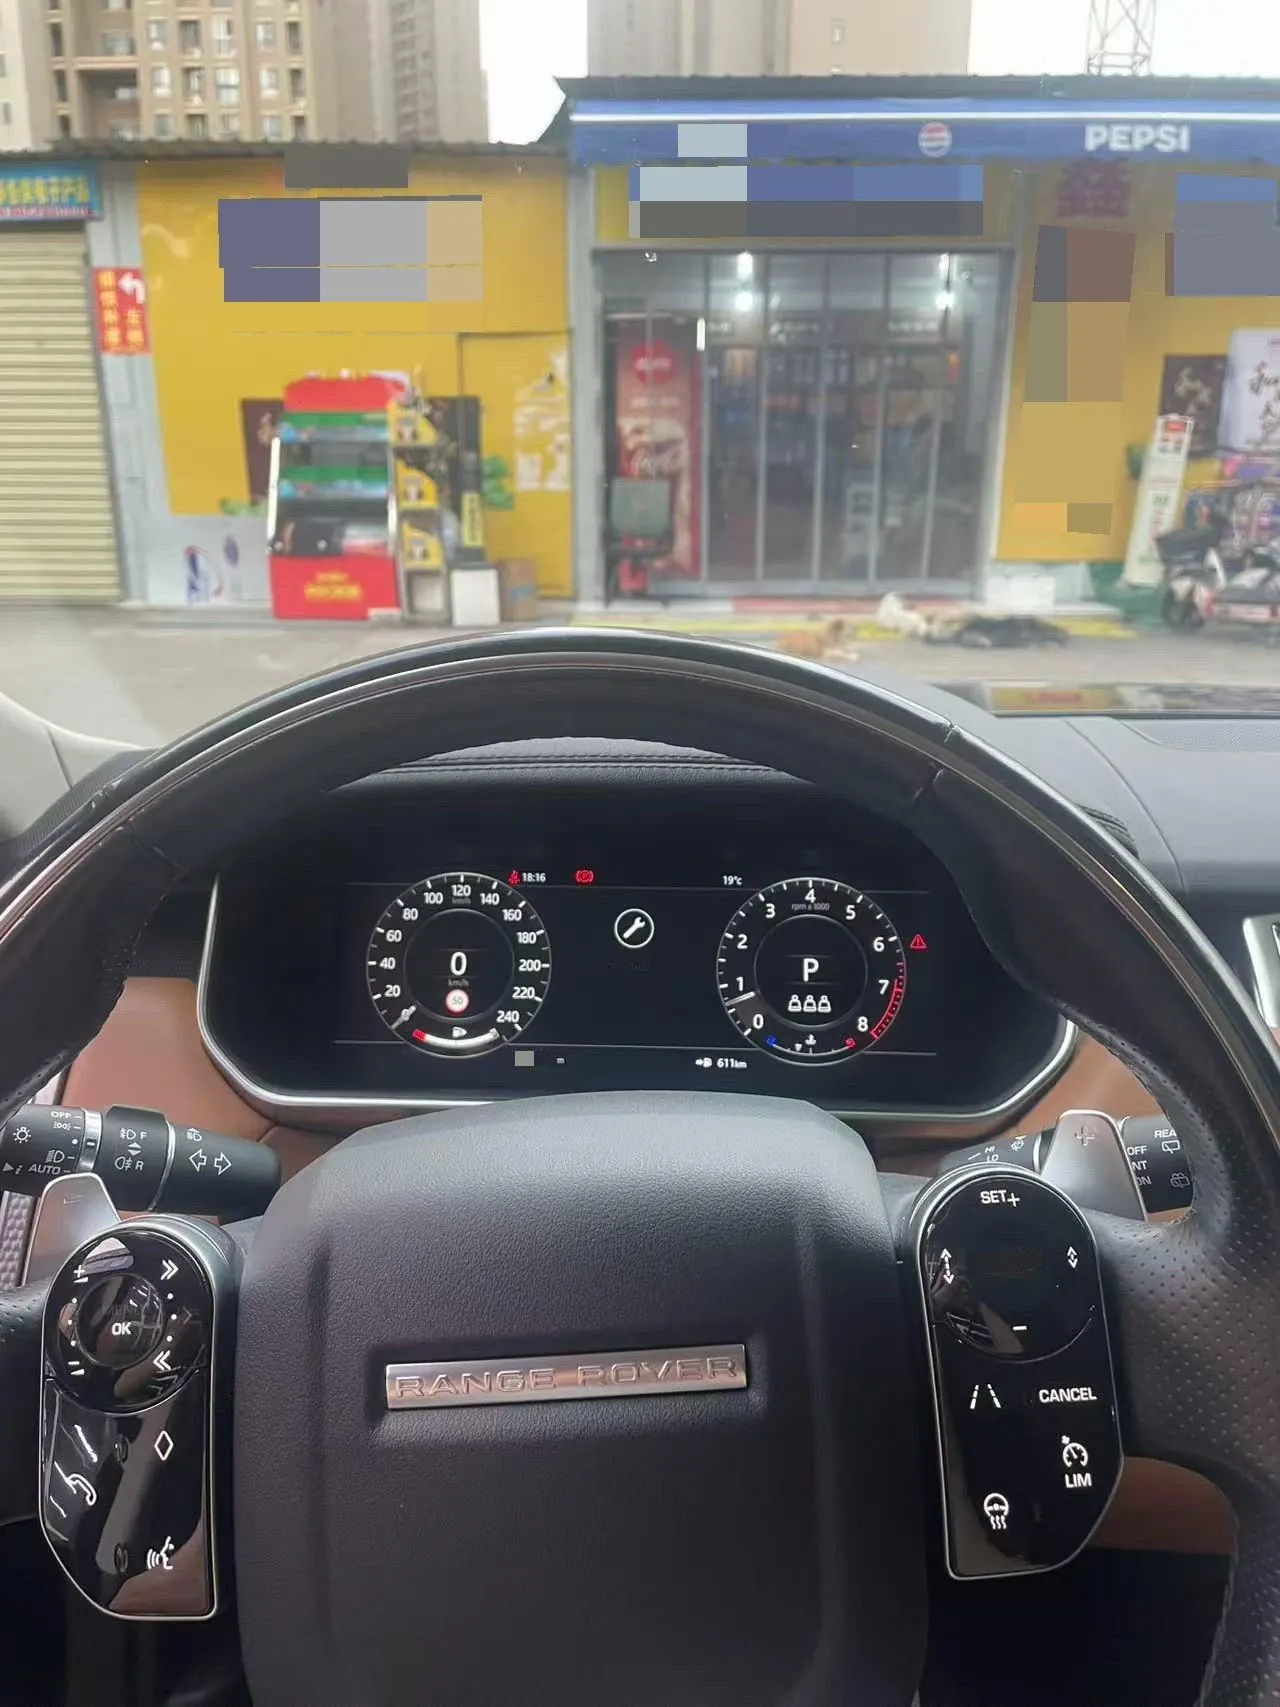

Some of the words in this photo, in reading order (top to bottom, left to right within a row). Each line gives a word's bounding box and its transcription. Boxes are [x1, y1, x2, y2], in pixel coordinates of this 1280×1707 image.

[1085, 124, 1191, 152] PEPSI
[522, 872, 546, 882] 18:16
[451, 885, 471, 896] 120
[804, 888, 817, 903] 4
[424, 892, 443, 904] 100
[480, 893, 500, 905] 140
[402, 908, 418, 920] 80
[502, 909, 522, 921] 160
[765, 903, 775, 918] 3
[846, 905, 856, 919] 5
[386, 930, 402, 942] 60
[516, 932, 537, 944] 180
[737, 934, 748, 949] 2
[873, 937, 885, 952] 6
[379, 957, 396, 970] 40
[450, 951, 467, 976] 0
[518, 959, 541, 972] 200
[803, 958, 819, 982] P
[736, 976, 744, 991] 1
[878, 979, 890, 995] 7
[385, 984, 401, 997] 20
[512, 986, 535, 999] 220
[496, 1010, 520, 1023] 240
[752, 1014, 764, 1029] 0
[857, 1016, 868, 1032] 8
[50, 1110, 72, 1118] OFF
[140, 1131, 148, 1140] F
[1154, 1128, 1178, 1138] REA
[985, 1145, 996, 1153] HI
[1126, 1145, 1148, 1156] OFF
[28, 1163, 61, 1175] AUTO
[134, 1160, 144, 1170] R
[1131, 1160, 1148, 1170] NT
[111, 1322, 132, 1335] OK
[396, 1368, 557, 1398] RANGE
[578, 1356, 737, 1387] ROVER
[1038, 1387, 1097, 1403] CANCEL
[1064, 1472, 1093, 1488] LIM
